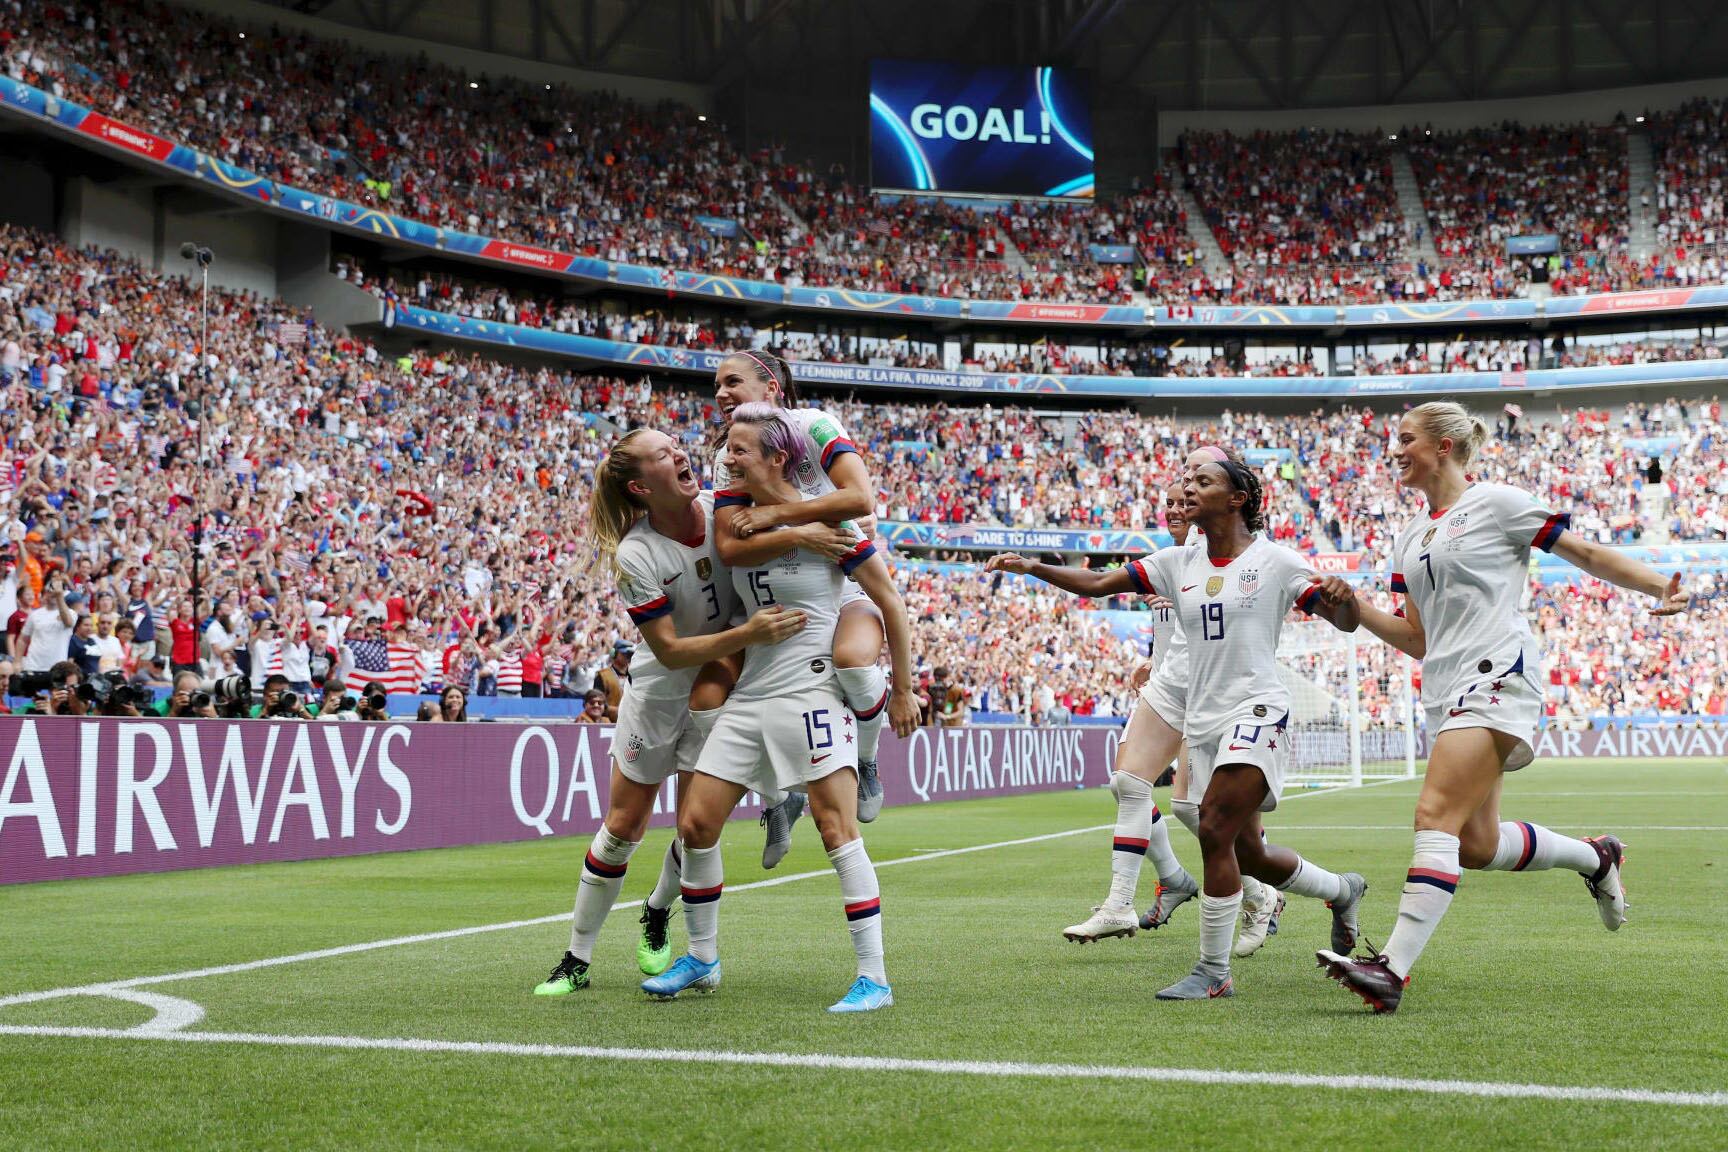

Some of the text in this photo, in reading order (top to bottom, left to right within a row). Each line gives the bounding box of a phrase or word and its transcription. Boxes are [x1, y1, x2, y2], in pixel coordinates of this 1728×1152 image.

[911, 104, 1051, 144] GOAL!
[856, 369, 871, 381] DE
[873, 370, 888, 382] LA
[916, 373, 957, 386] FRANCE
[973, 531, 1064, 548] DARE TO SHINE
[748, 570, 776, 607] 15
[1419, 553, 1436, 591] 7
[701, 583, 721, 622] 3
[1200, 603, 1225, 641] 19
[802, 709, 833, 750] 15
[1593, 729, 1728, 757] AIRWAY
[908, 728, 995, 801] QATAR
[1000, 729, 1085, 788] AIRWAYS
[0, 719, 412, 858] AIRWAYS
